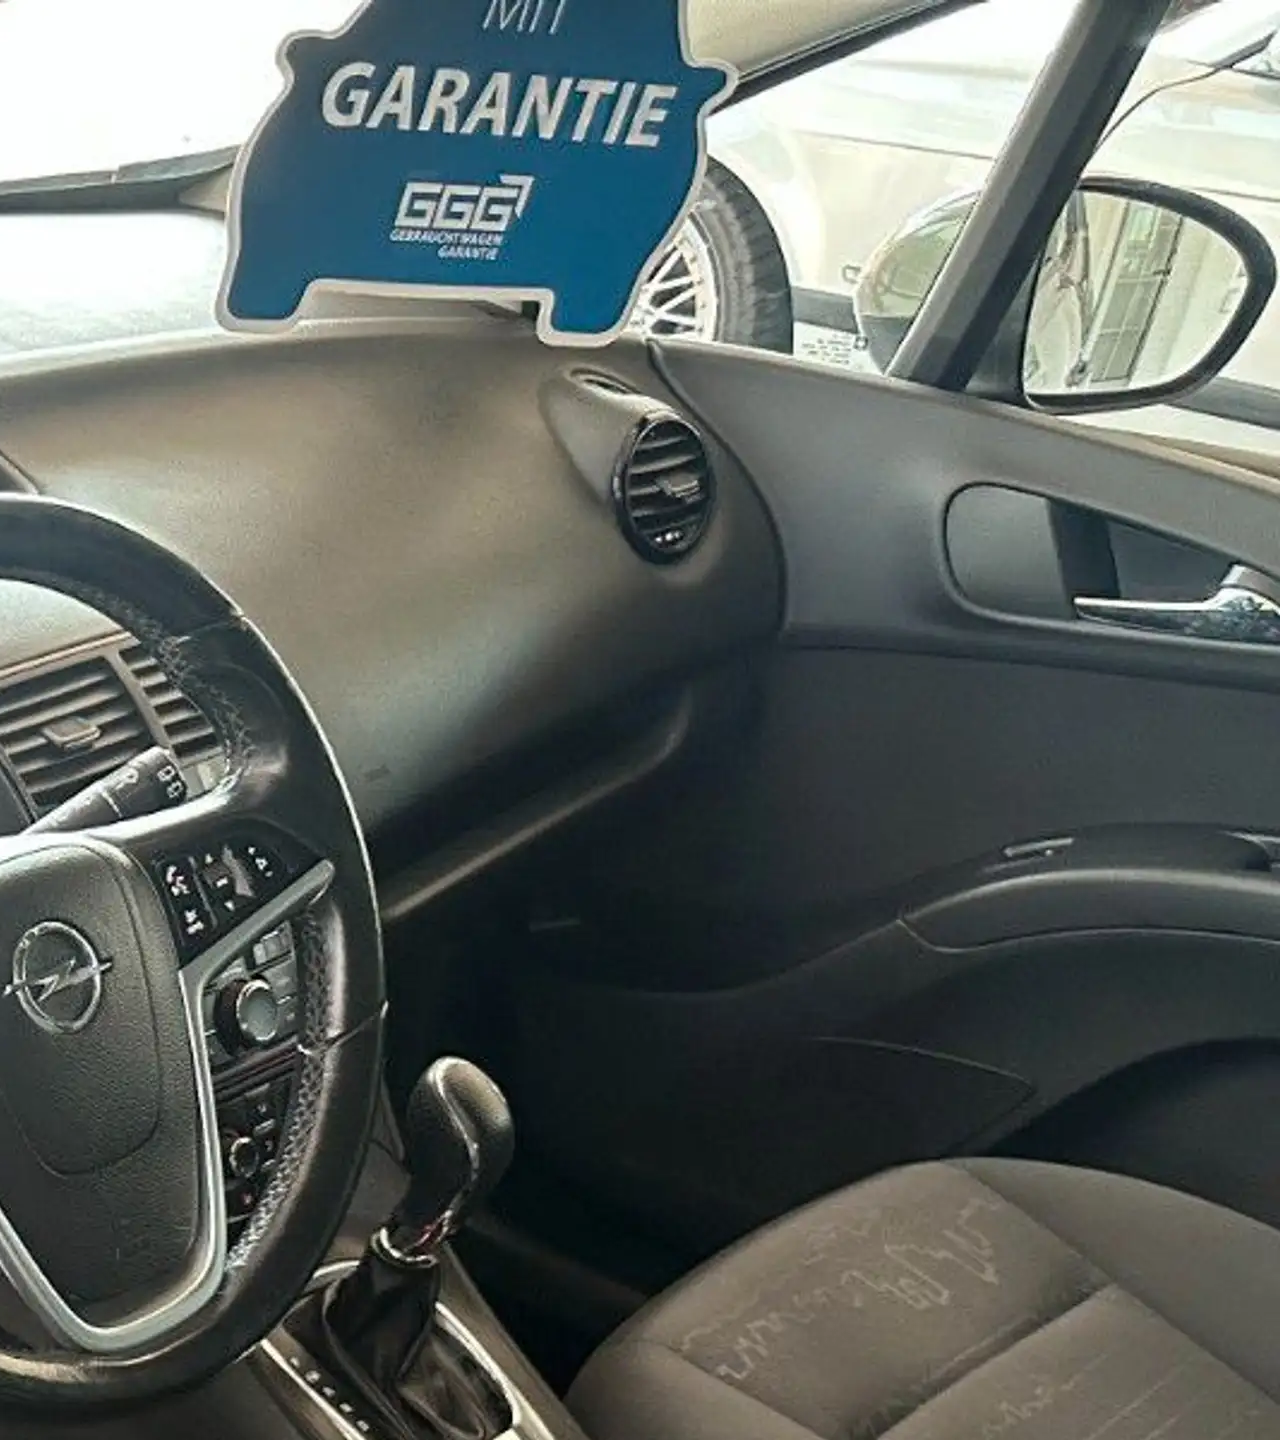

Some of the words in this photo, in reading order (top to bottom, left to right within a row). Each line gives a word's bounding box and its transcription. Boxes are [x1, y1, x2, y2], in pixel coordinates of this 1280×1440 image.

[321, 61, 677, 148] GARANTIE
[395, 180, 520, 231] GGG
[389, 228, 505, 247] GEBRAUCHTWAGEN
[437, 244, 500, 261] GARANTIE
